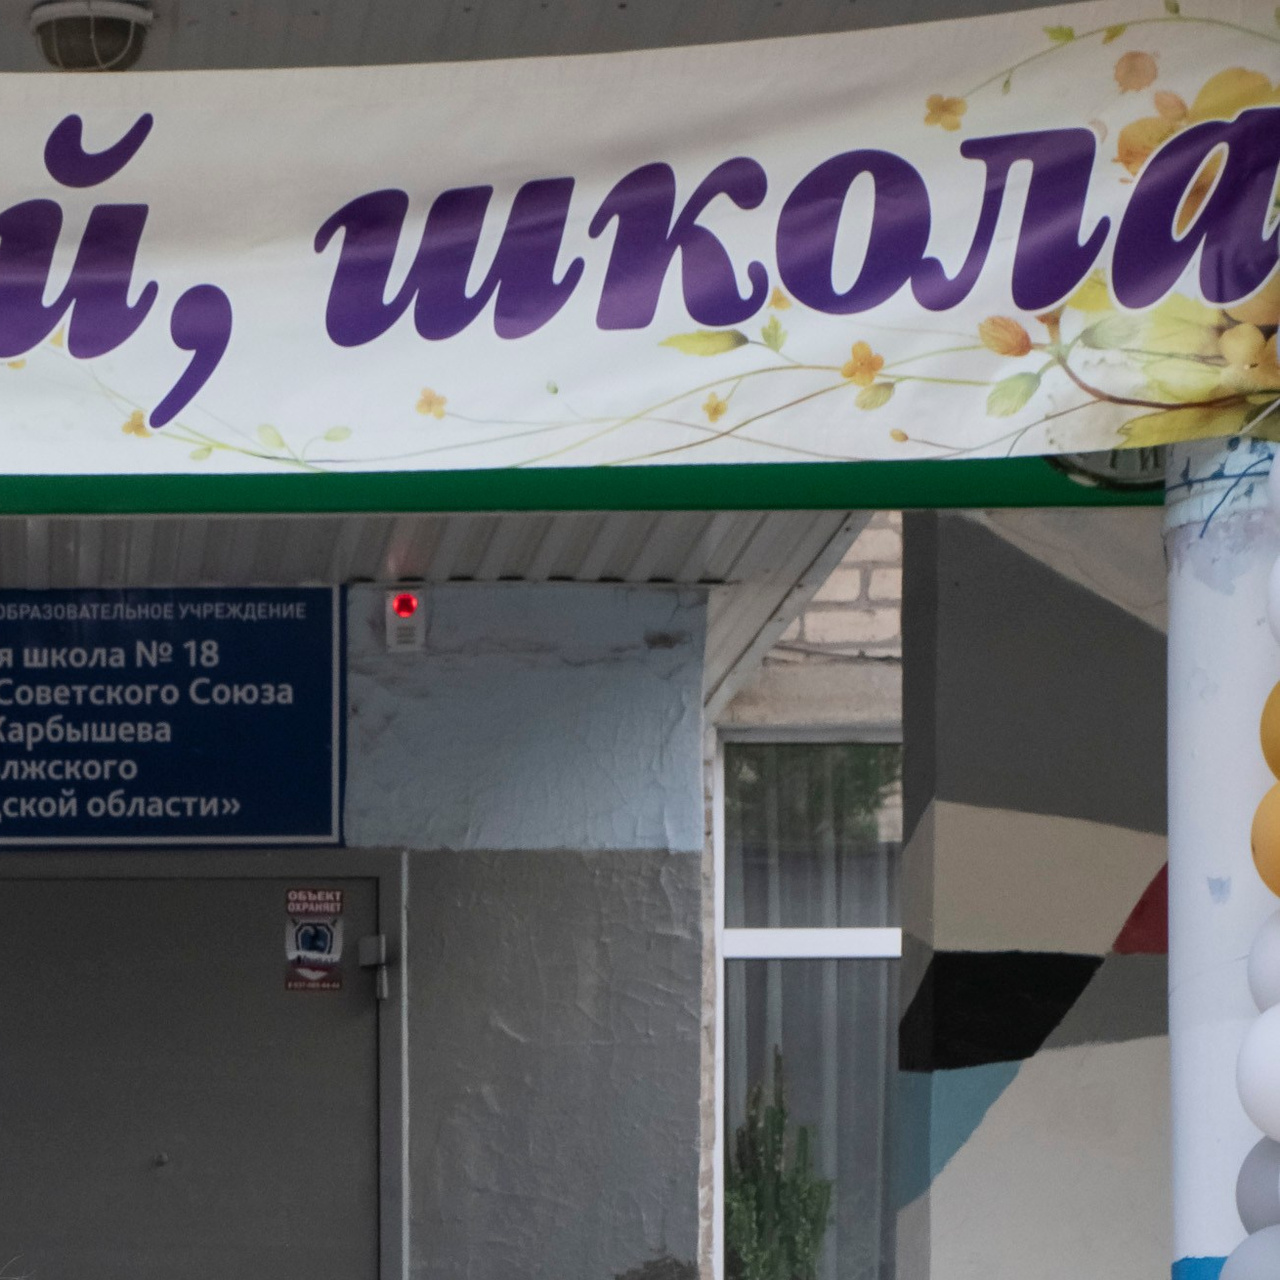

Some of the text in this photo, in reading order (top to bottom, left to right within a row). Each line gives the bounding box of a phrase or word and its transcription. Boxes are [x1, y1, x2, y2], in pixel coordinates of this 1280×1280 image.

[313, 106, 1280, 348] школа
[178, 602, 306, 620] УЧРЕЖДЕНИЕ
[23, 646, 126, 668] школа
[135, 640, 173, 668] №
[183, 640, 220, 668] 18
[188, 678, 294, 705] Союза
[86, 788, 241, 818] области»
[288, 891, 341, 901] ОБЪЕКТ
